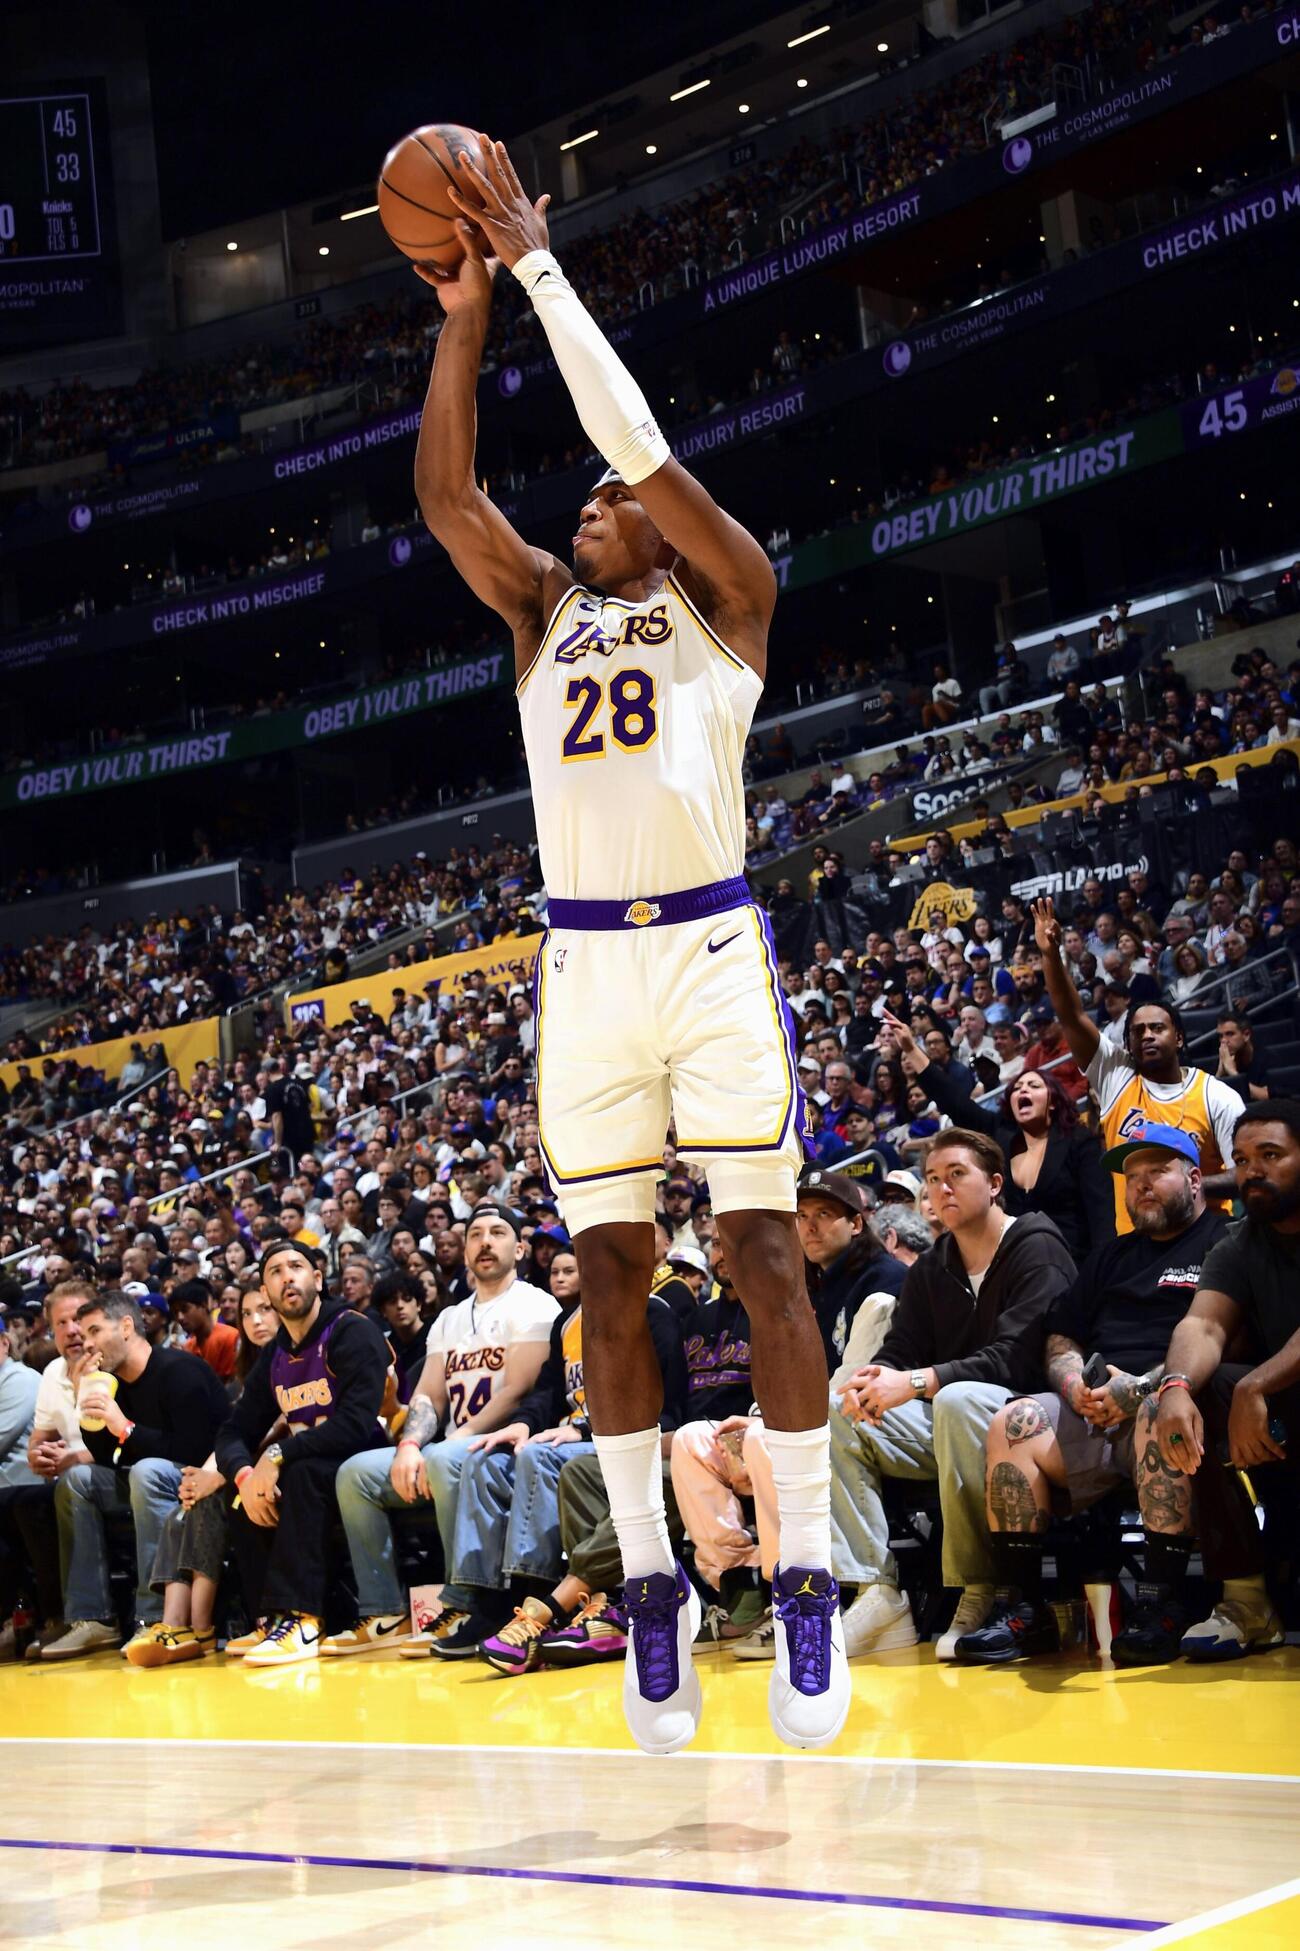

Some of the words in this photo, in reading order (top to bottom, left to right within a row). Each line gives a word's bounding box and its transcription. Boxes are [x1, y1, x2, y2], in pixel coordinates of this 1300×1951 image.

[53, 109, 77, 137] 45
[1035, 127, 1061, 149] THE
[1064, 73, 1172, 136] COSMOPOLITAN
[56, 153, 80, 182] 33
[704, 293, 716, 312] A
[719, 261, 781, 304] UNIQUE
[784, 229, 849, 275] LUXURY
[852, 195, 921, 243] RESORT
[1143, 220, 1218, 268] CHECK
[1223, 197, 1276, 236] INTO
[915, 333, 938, 353] THE
[941, 288, 1044, 343] COSMOPOLITAN
[524, 360, 545, 378] THE
[175, 426, 214, 445] ULTRA
[672, 421, 736, 463] LUXURY
[741, 392, 805, 435] RESORT
[1199, 389, 1248, 438] 45
[1261, 396, 1300, 421] ASSIST
[274, 446, 326, 479] CHECK
[329, 436, 362, 462] INTO
[364, 411, 421, 446] MISCHIE
[116, 480, 200, 512] COSMOPOLITAN
[872, 498, 942, 555] OBEY
[946, 472, 1025, 530] YOUR
[1029, 431, 1135, 500] THIRST
[153, 605, 208, 633] CHECK
[211, 596, 250, 620] INTO
[254, 573, 326, 609] MISCHIEF
[304, 698, 358, 739] OBEY
[361, 680, 421, 722] YOUR
[424, 654, 504, 703] THIRST
[561, 667, 659, 764] 28
[17, 766, 77, 800] OBEY
[81, 752, 146, 788] YOUR
[147, 732, 232, 778] THIRST
[1010, 871, 1063, 900] ESPN
[1094, 863, 1122, 881] 710
[624, 902, 661, 921] LAKERS
[445, 1346, 505, 1380] LAKERS
[449, 1376, 493, 1429] 24
